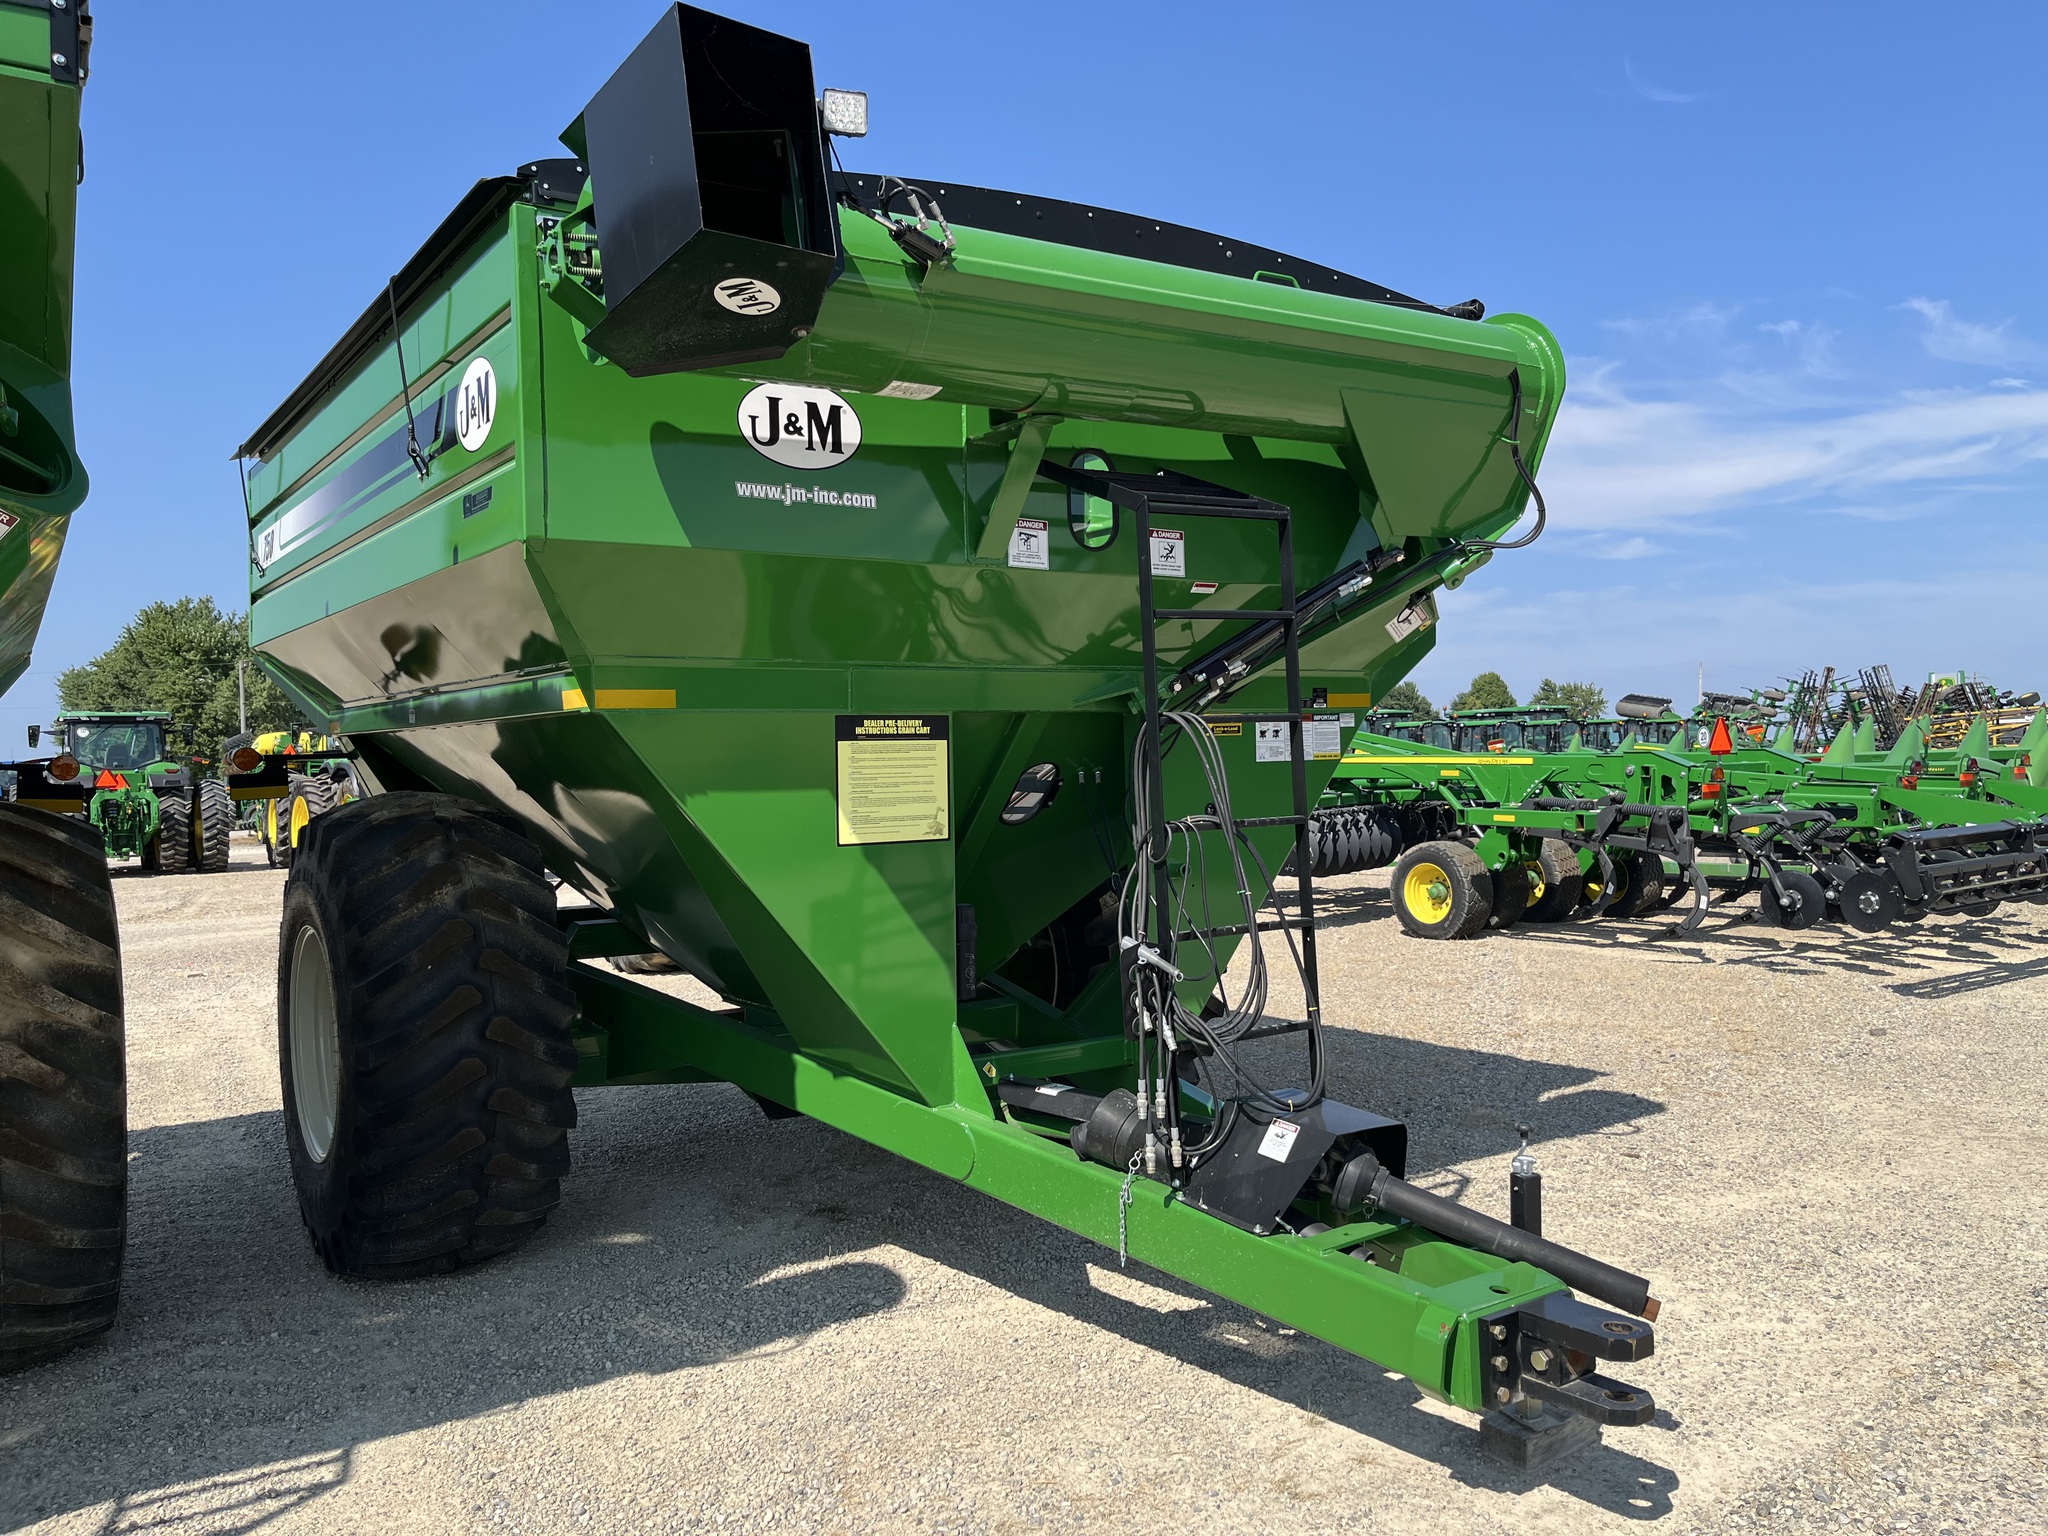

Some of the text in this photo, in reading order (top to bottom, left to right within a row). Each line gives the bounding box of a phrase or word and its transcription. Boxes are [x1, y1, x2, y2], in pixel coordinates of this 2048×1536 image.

[718, 280, 776, 313] J&M
[459, 369, 491, 439] J&M
[748, 395, 845, 455] J&M
[735, 481, 877, 509] www.jm-inc.com
[1018, 520, 1045, 529] DANGER
[1158, 531, 1181, 539] DANGER
[855, 726, 931, 734] INSTRUCTIONS GRAIN CART
[863, 719, 923, 727] DEALER PRE-DELIVERY
